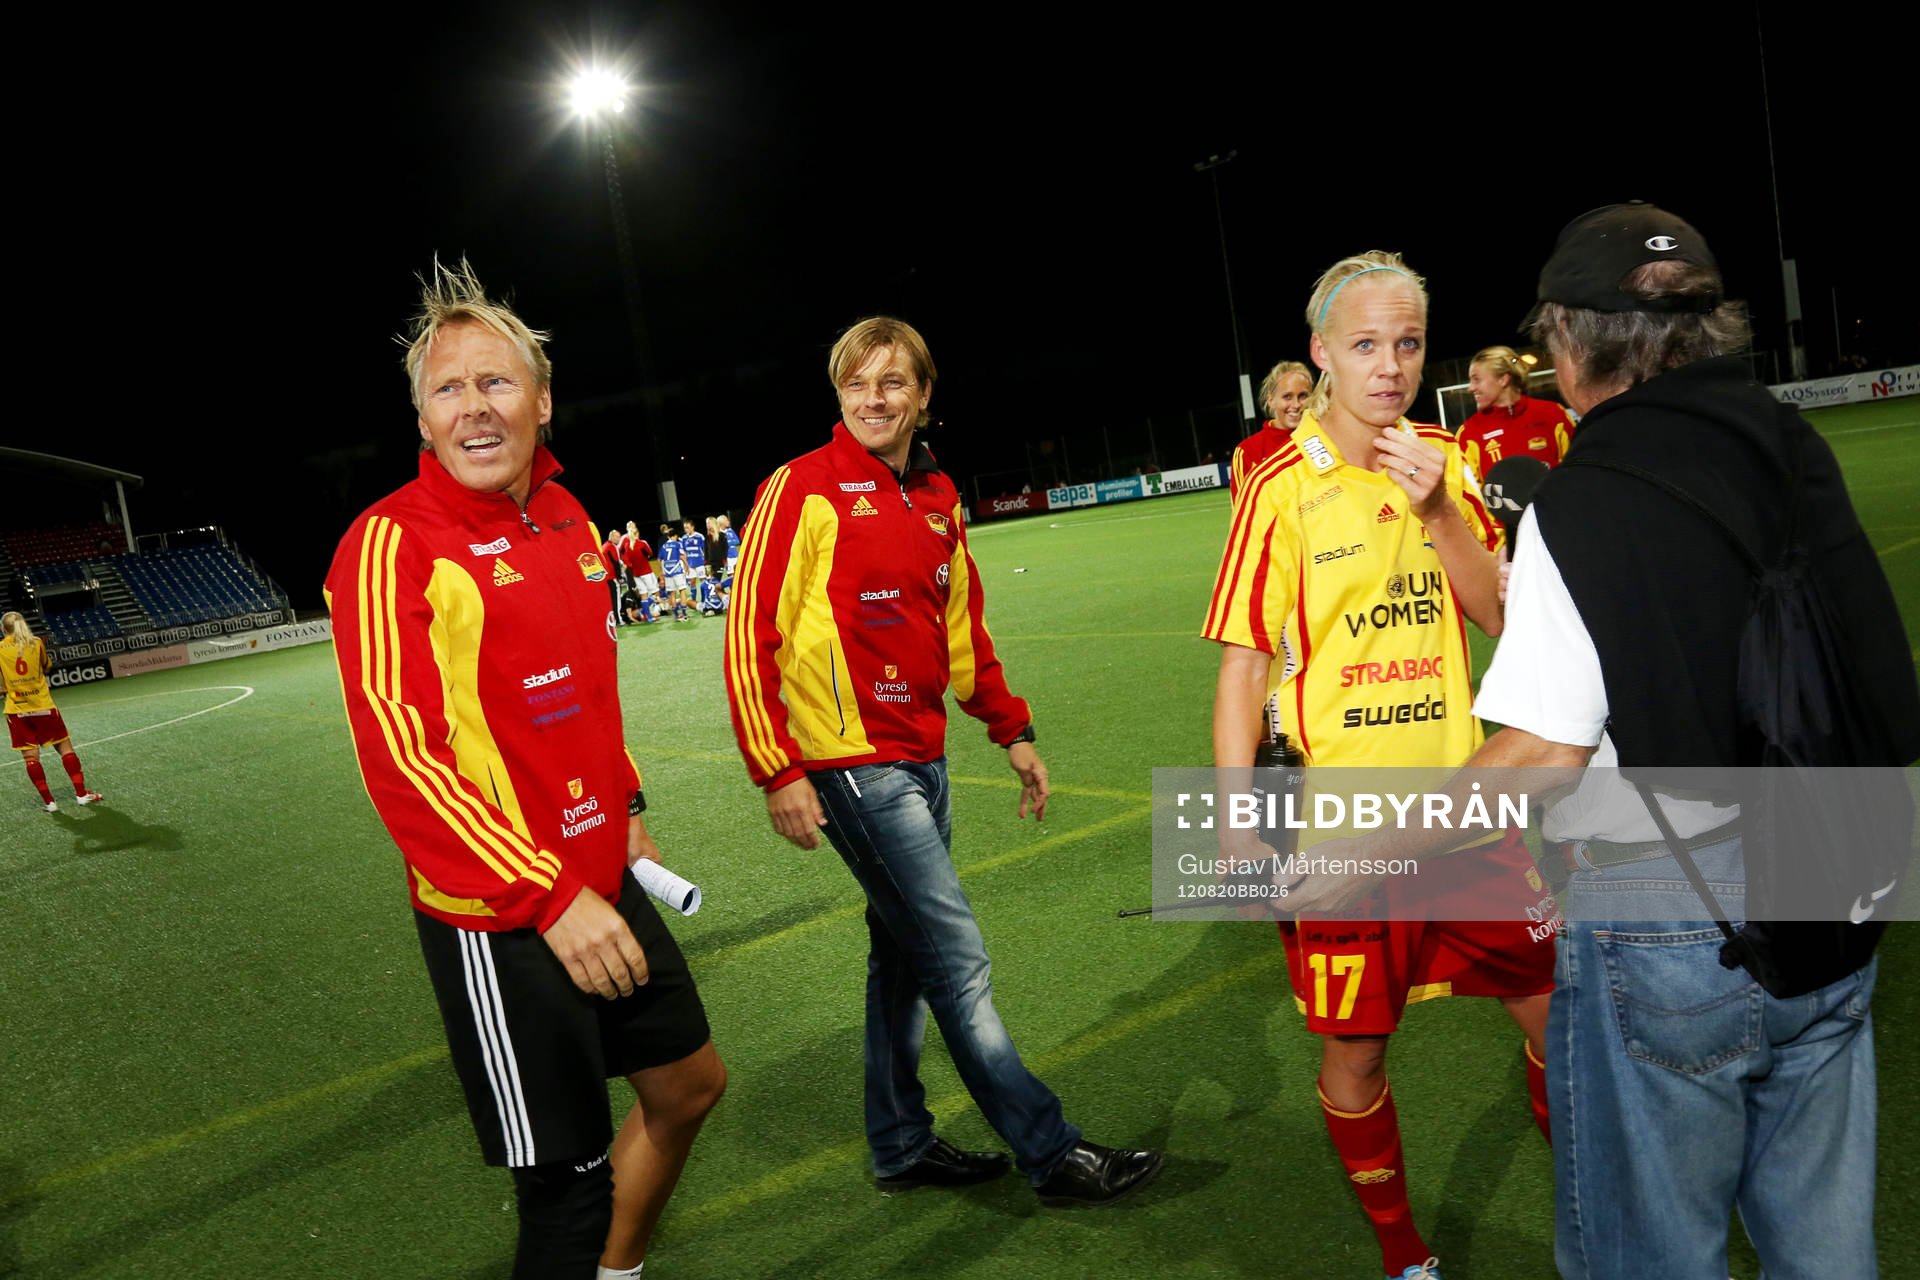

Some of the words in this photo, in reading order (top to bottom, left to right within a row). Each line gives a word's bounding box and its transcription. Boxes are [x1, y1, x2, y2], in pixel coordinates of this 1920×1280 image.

[1782, 385, 1848, 401] AQSystem
[1871, 382, 1920, 397] Netw
[1145, 473, 1162, 494] T
[1164, 475, 1214, 493] EMBALLAGE
[1105, 489, 1133, 500] profiler
[852, 508, 878, 517] adidas
[993, 497, 1029, 512] Scandic
[1377, 514, 1400, 524] adidas
[666, 548, 673, 560] 7
[1314, 544, 1366, 564] stadium
[494, 573, 524, 587] adidas
[1409, 571, 1442, 597] UN
[708, 584, 715, 596] 2
[860, 588, 900, 601] stadium
[1345, 599, 1443, 638] WOMEN
[266, 625, 326, 643] FONTANA
[15, 657, 28, 675] 6
[523, 664, 571, 689] stadium
[875, 681, 907, 693] tyresö
[563, 796, 598, 823] tyresö
[561, 813, 605, 838] kommun
[1308, 953, 1366, 1019] 17
